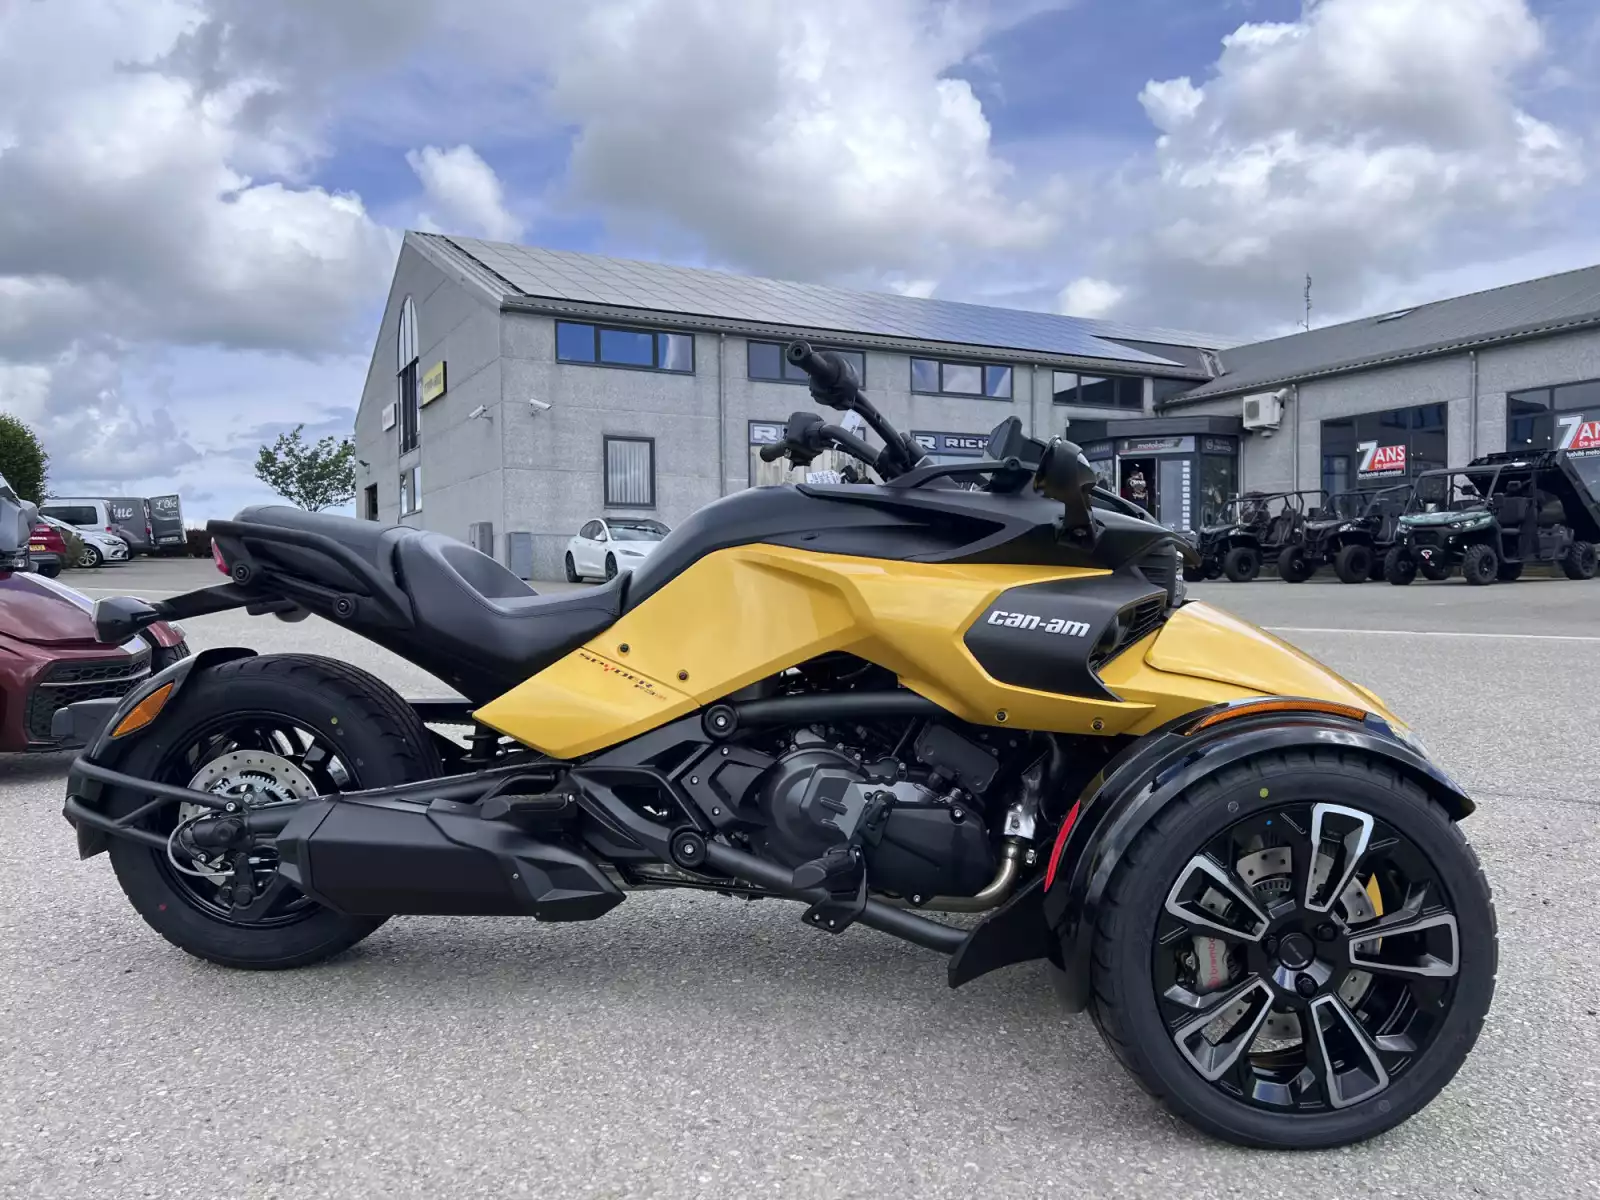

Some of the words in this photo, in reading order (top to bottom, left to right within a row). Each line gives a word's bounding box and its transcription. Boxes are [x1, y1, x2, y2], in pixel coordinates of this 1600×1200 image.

[753, 426, 778, 441] R
[945, 438, 988, 448] RICH
[1357, 440, 1378, 472] 7
[1374, 445, 1405, 463] ANS
[987, 610, 1091, 637] can-am
